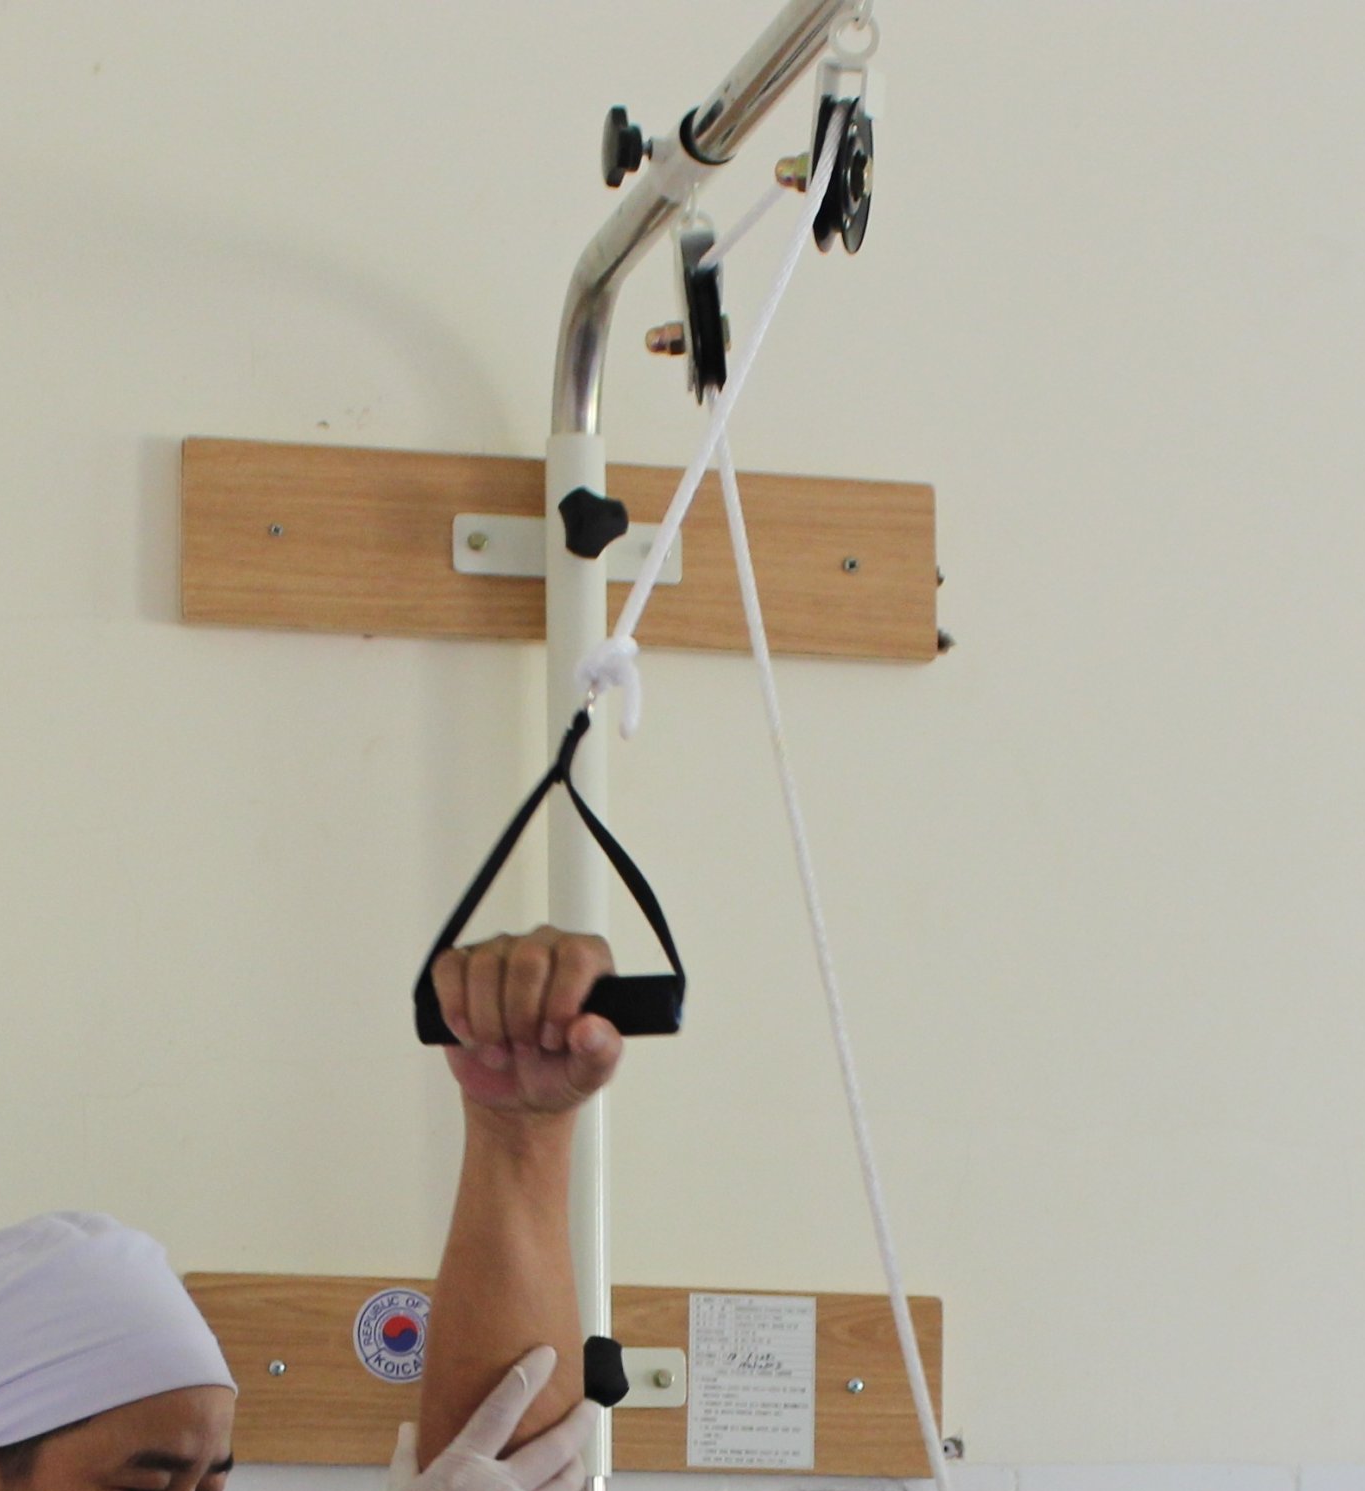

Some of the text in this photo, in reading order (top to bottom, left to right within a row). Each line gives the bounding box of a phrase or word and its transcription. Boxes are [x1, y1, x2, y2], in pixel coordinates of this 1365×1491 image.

[362, 1296, 399, 1346] REPUBLIC
[406, 1297, 421, 1309] OF
[374, 1354, 422, 1375] KOICA
